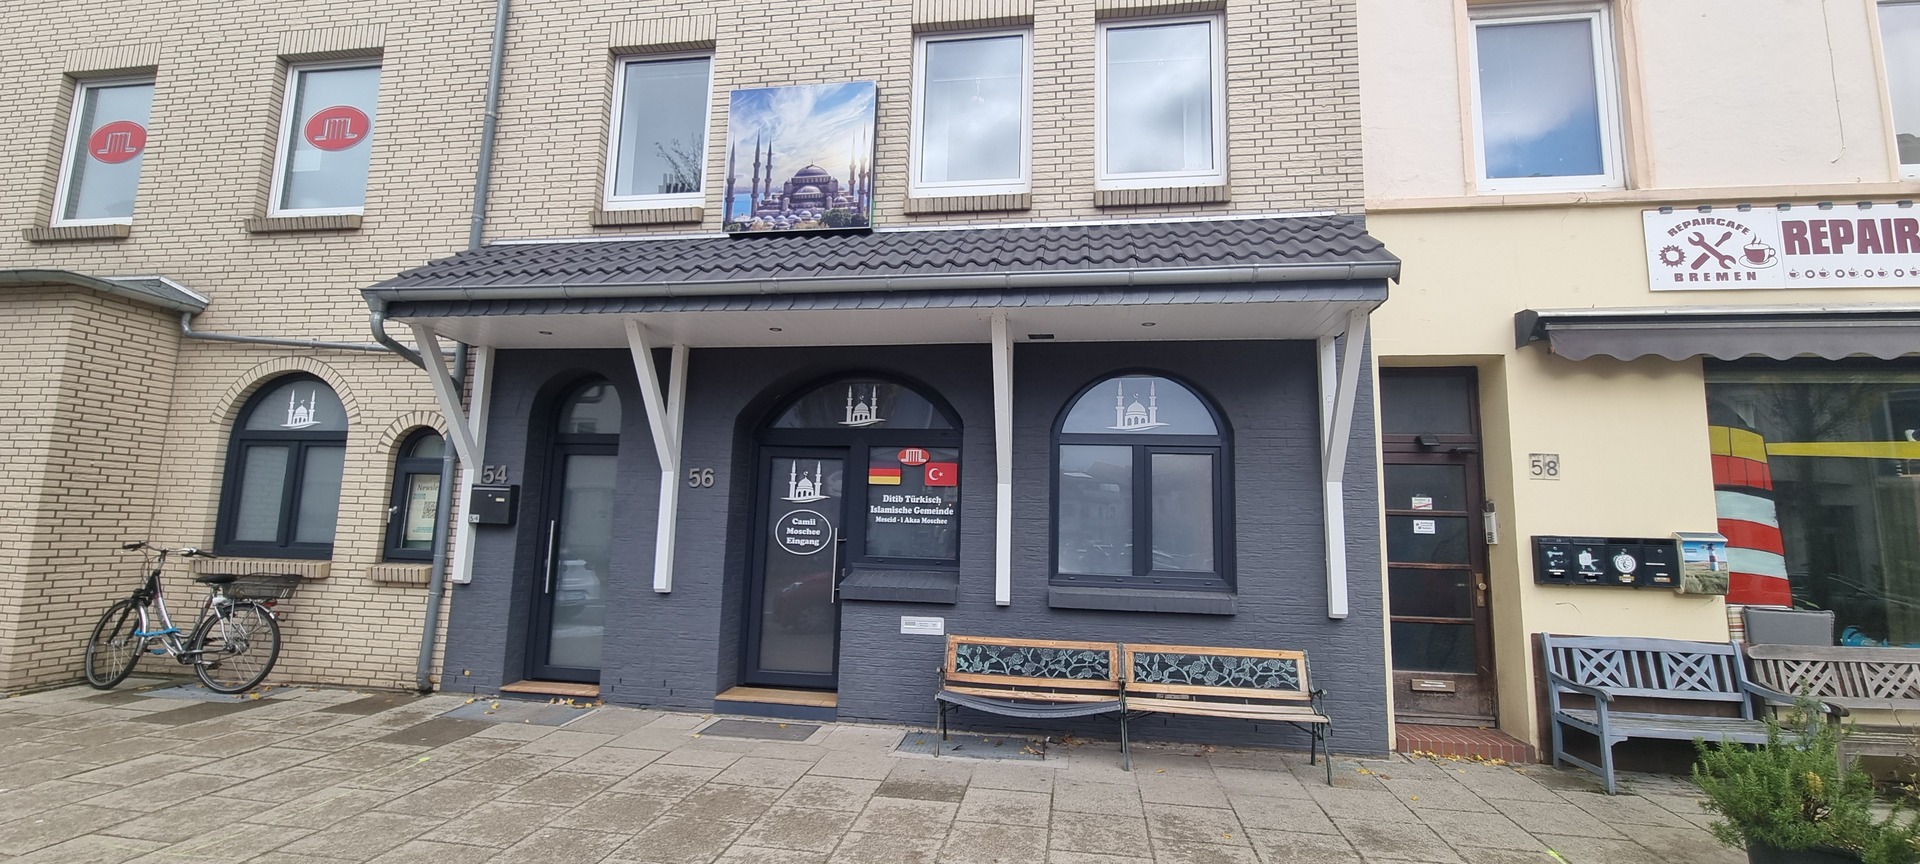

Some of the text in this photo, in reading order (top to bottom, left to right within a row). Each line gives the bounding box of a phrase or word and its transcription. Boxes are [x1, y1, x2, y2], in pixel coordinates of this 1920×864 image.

[1667, 218, 1750, 237] REPAIRCAFE
[1781, 218, 1920, 255] REPAIR
[1674, 272, 1757, 282] BREMEN
[1531, 459, 1558, 476] 58
[482, 464, 507, 484] 54
[688, 467, 715, 488] 56
[882, 494, 942, 504] Ditib Türkisch
[870, 505, 954, 515] Islamische Gemeinde
[792, 518, 816, 526] Camii
[921, 517, 948, 525] Moschee
[786, 527, 821, 536] Moschee
[786, 537, 820, 547] Eingang
